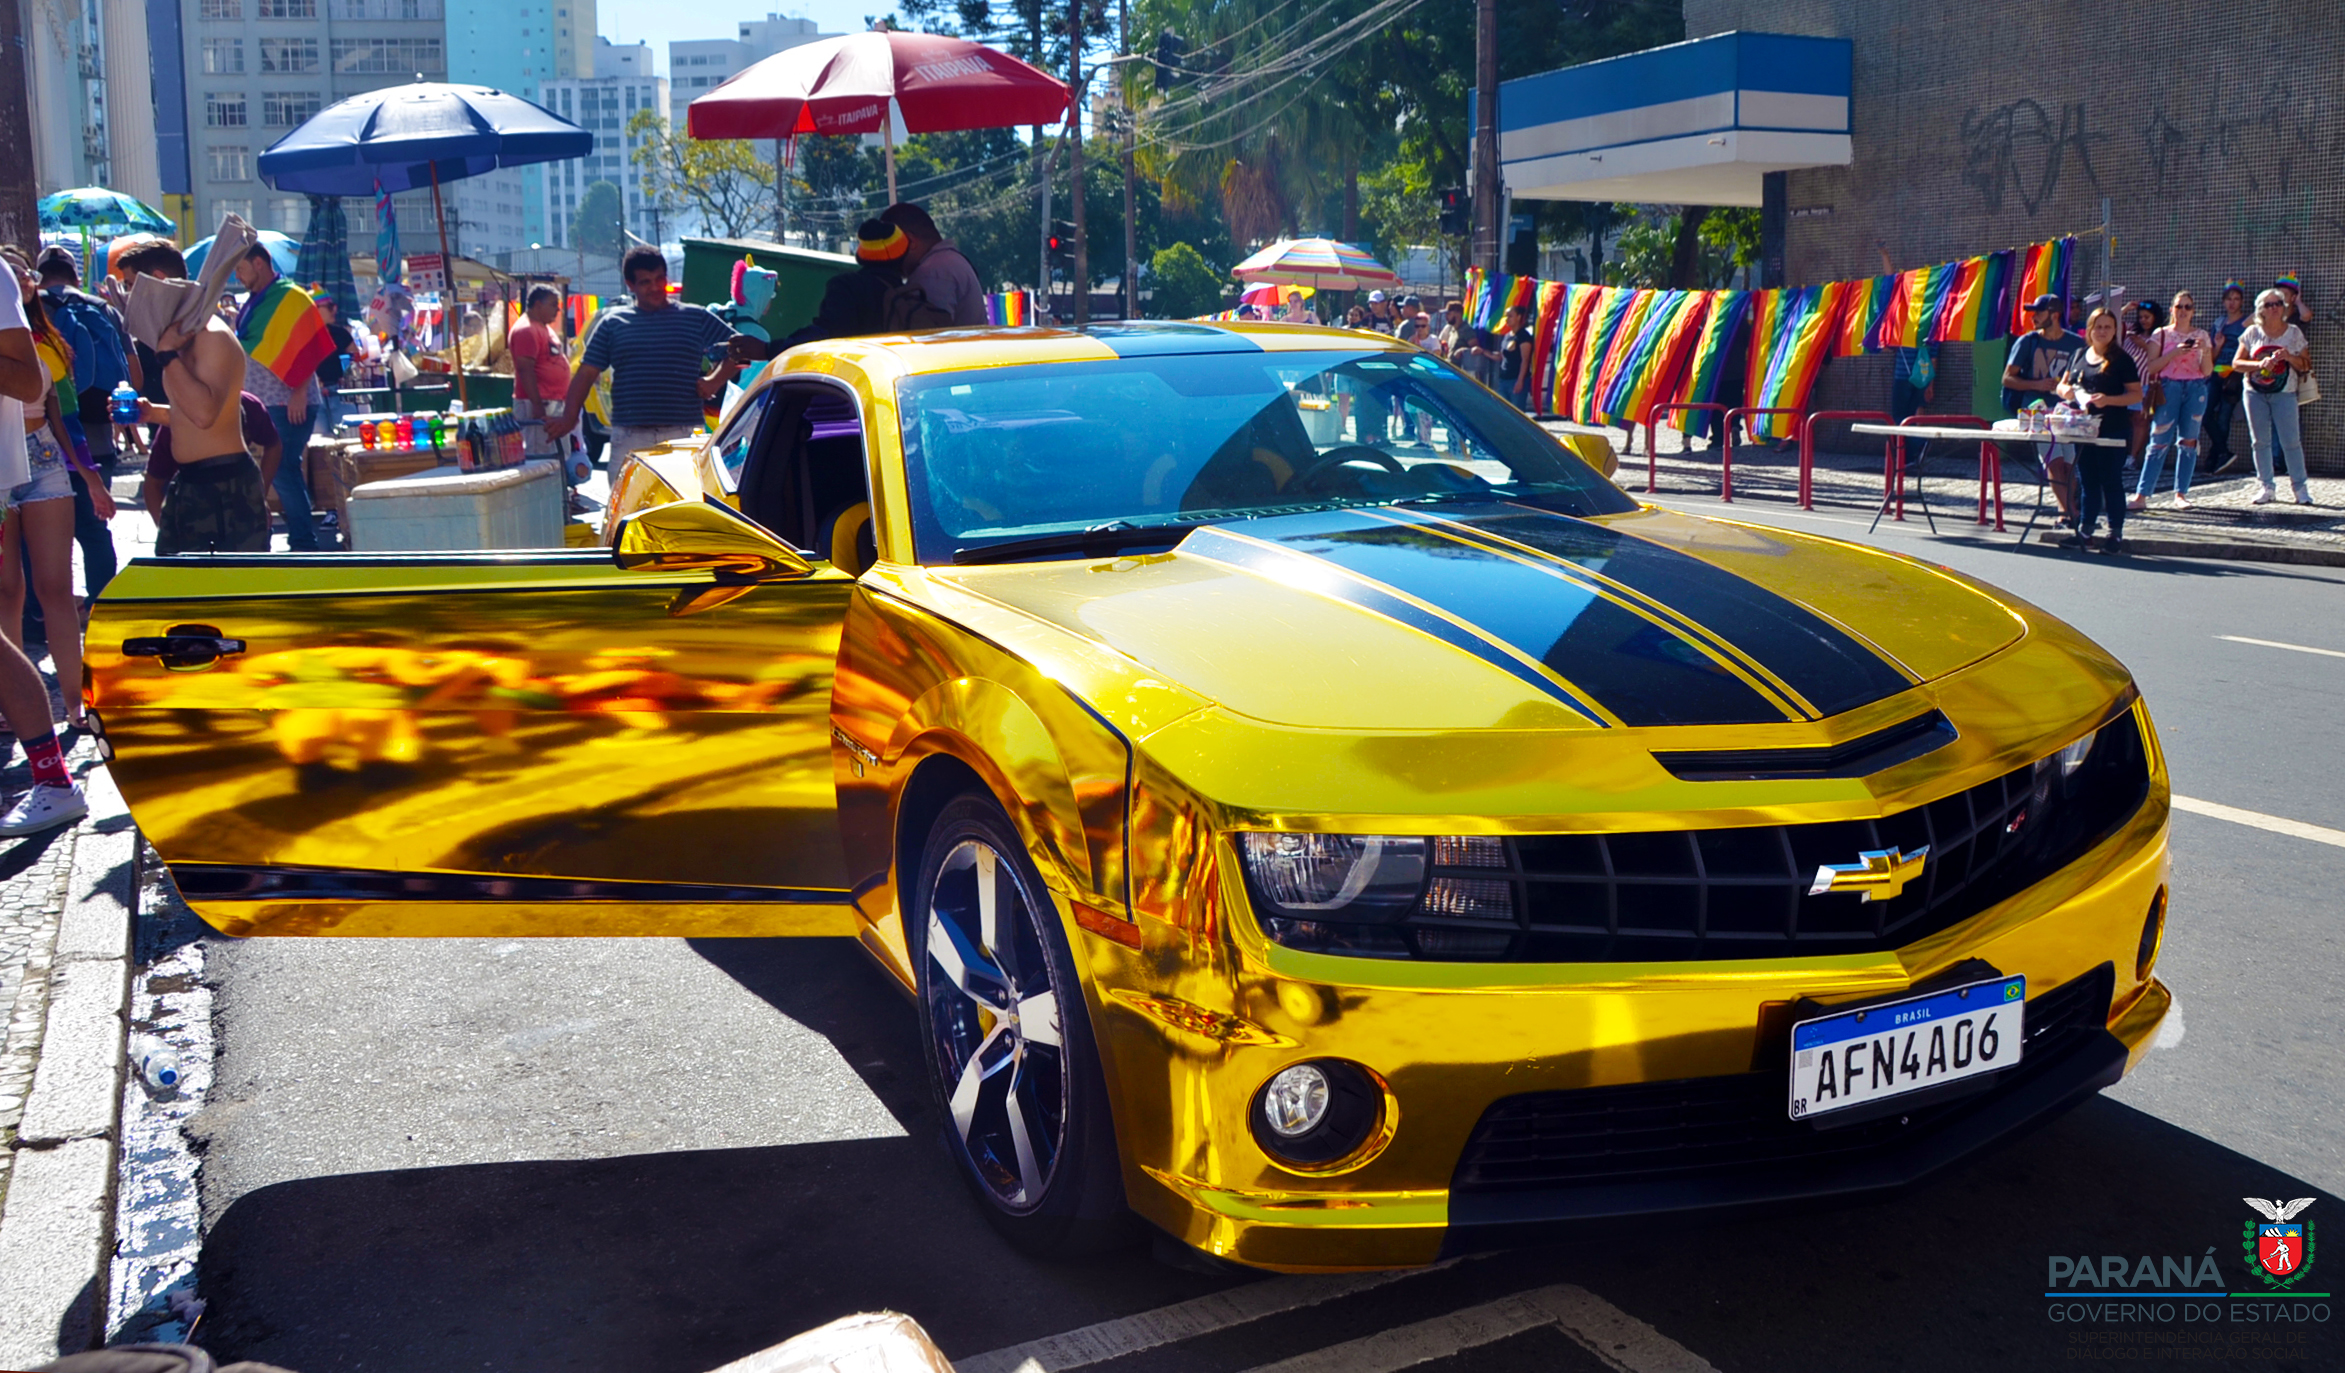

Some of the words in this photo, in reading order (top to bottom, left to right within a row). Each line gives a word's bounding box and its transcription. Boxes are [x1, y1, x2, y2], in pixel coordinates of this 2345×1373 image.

[915, 55, 994, 82] ITAIPAVA
[838, 104, 878, 126] ITAIPAVA
[1895, 1007, 1931, 1025] BRASIL
[1815, 1012, 1999, 1103] AFN4A06
[1793, 1098, 1807, 1116] BR
